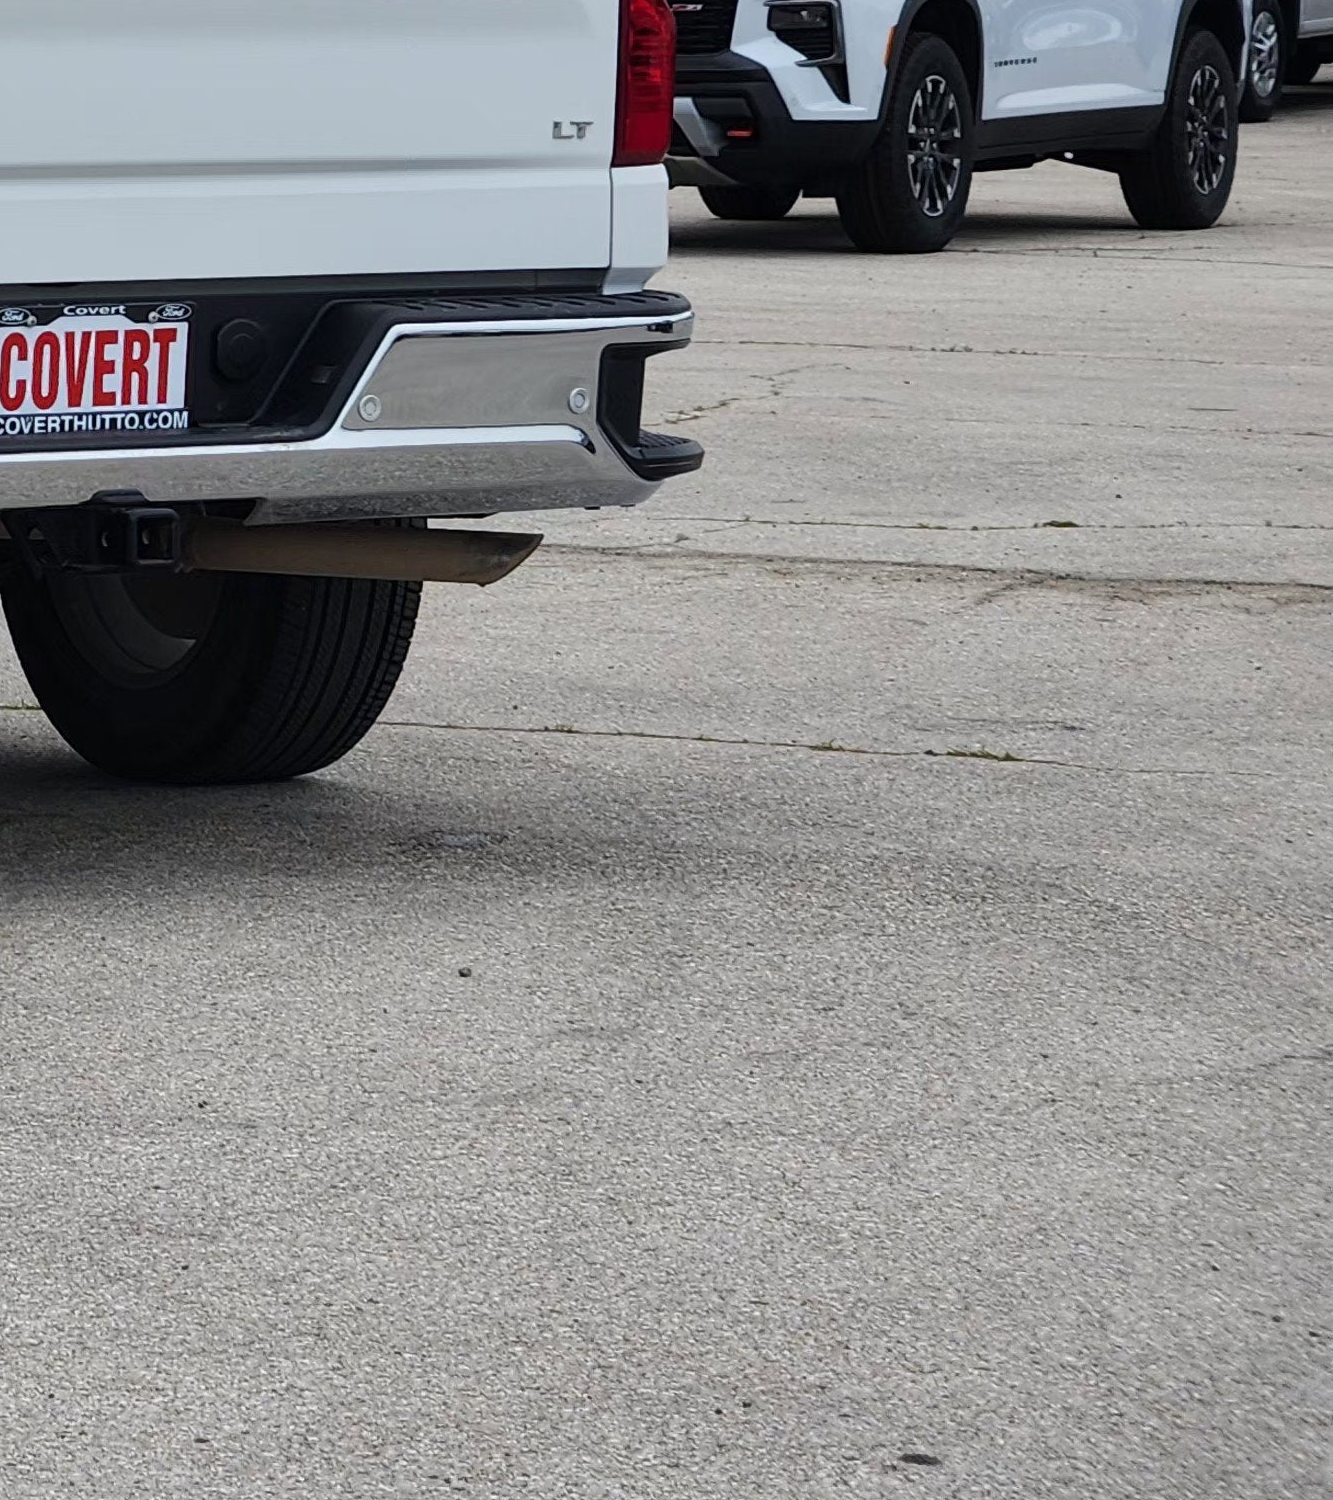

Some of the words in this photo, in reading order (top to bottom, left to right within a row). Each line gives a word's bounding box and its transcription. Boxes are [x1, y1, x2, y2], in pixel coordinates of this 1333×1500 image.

[553, 121, 594, 140] LT
[62, 304, 127, 316] Covert
[0, 328, 178, 412] COVERT
